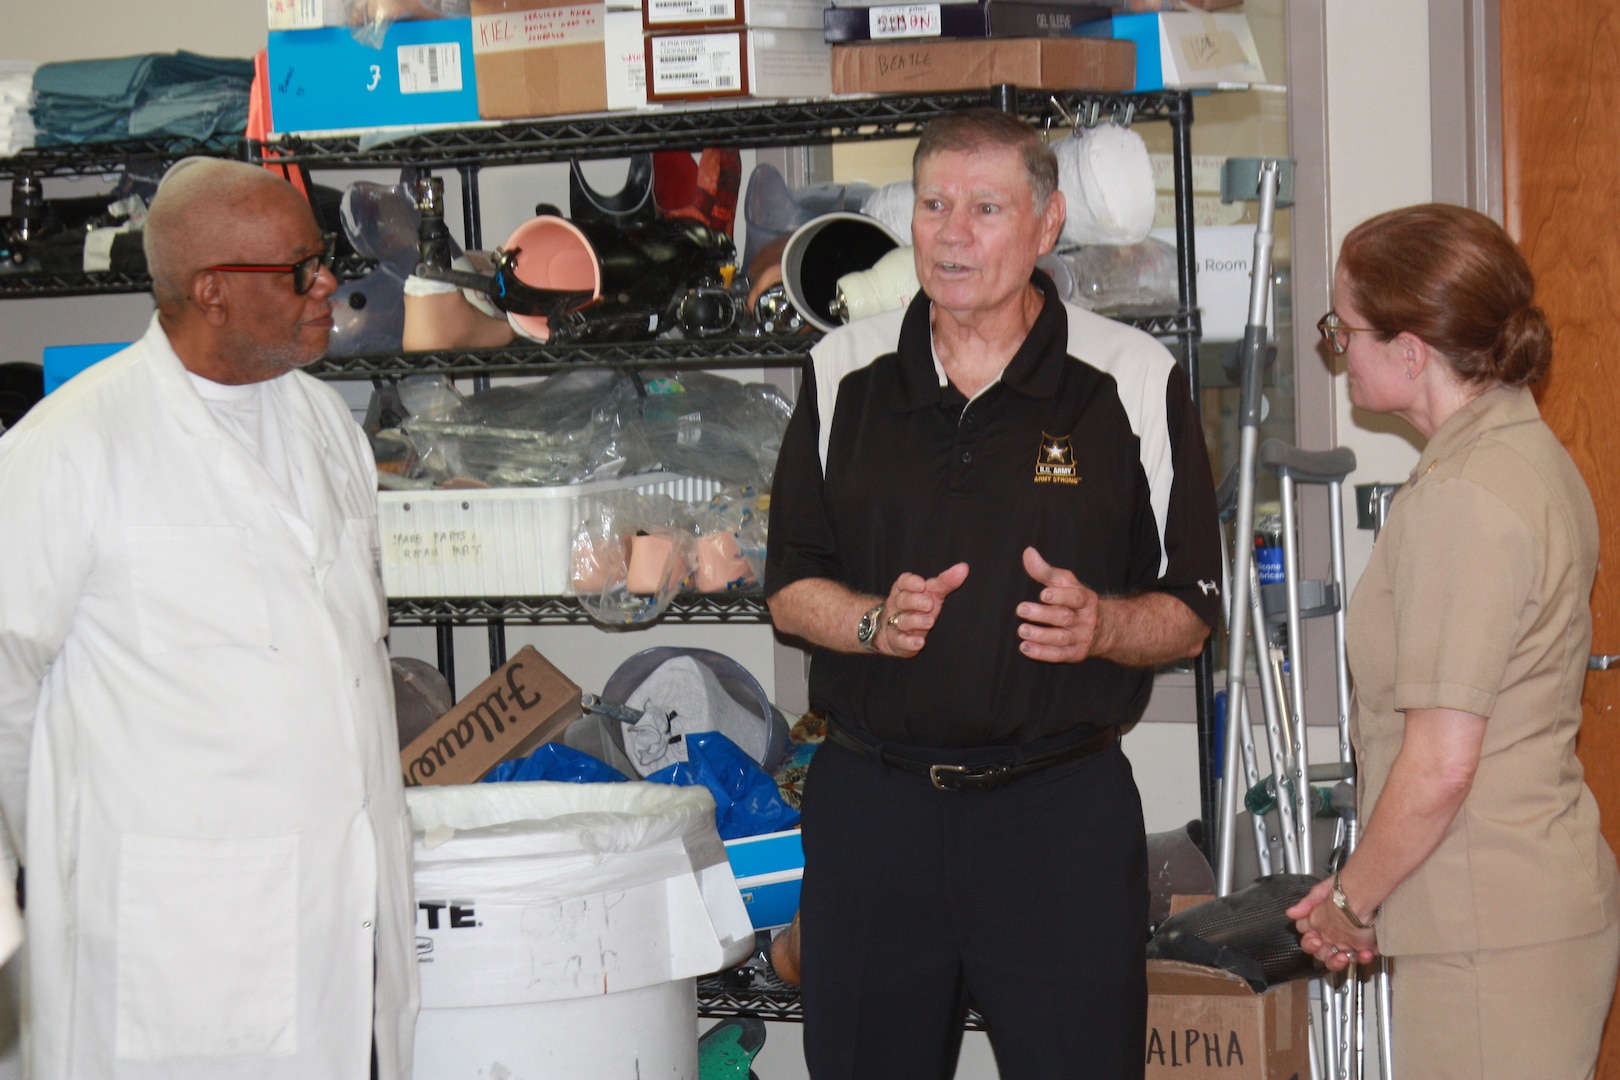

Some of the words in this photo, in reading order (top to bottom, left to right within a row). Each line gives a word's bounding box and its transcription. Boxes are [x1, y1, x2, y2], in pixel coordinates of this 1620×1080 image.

[1205, 258, 1247, 272] Room
[1052, 466, 1072, 474] ARMY
[1146, 1028, 1243, 1067] ALPHA
